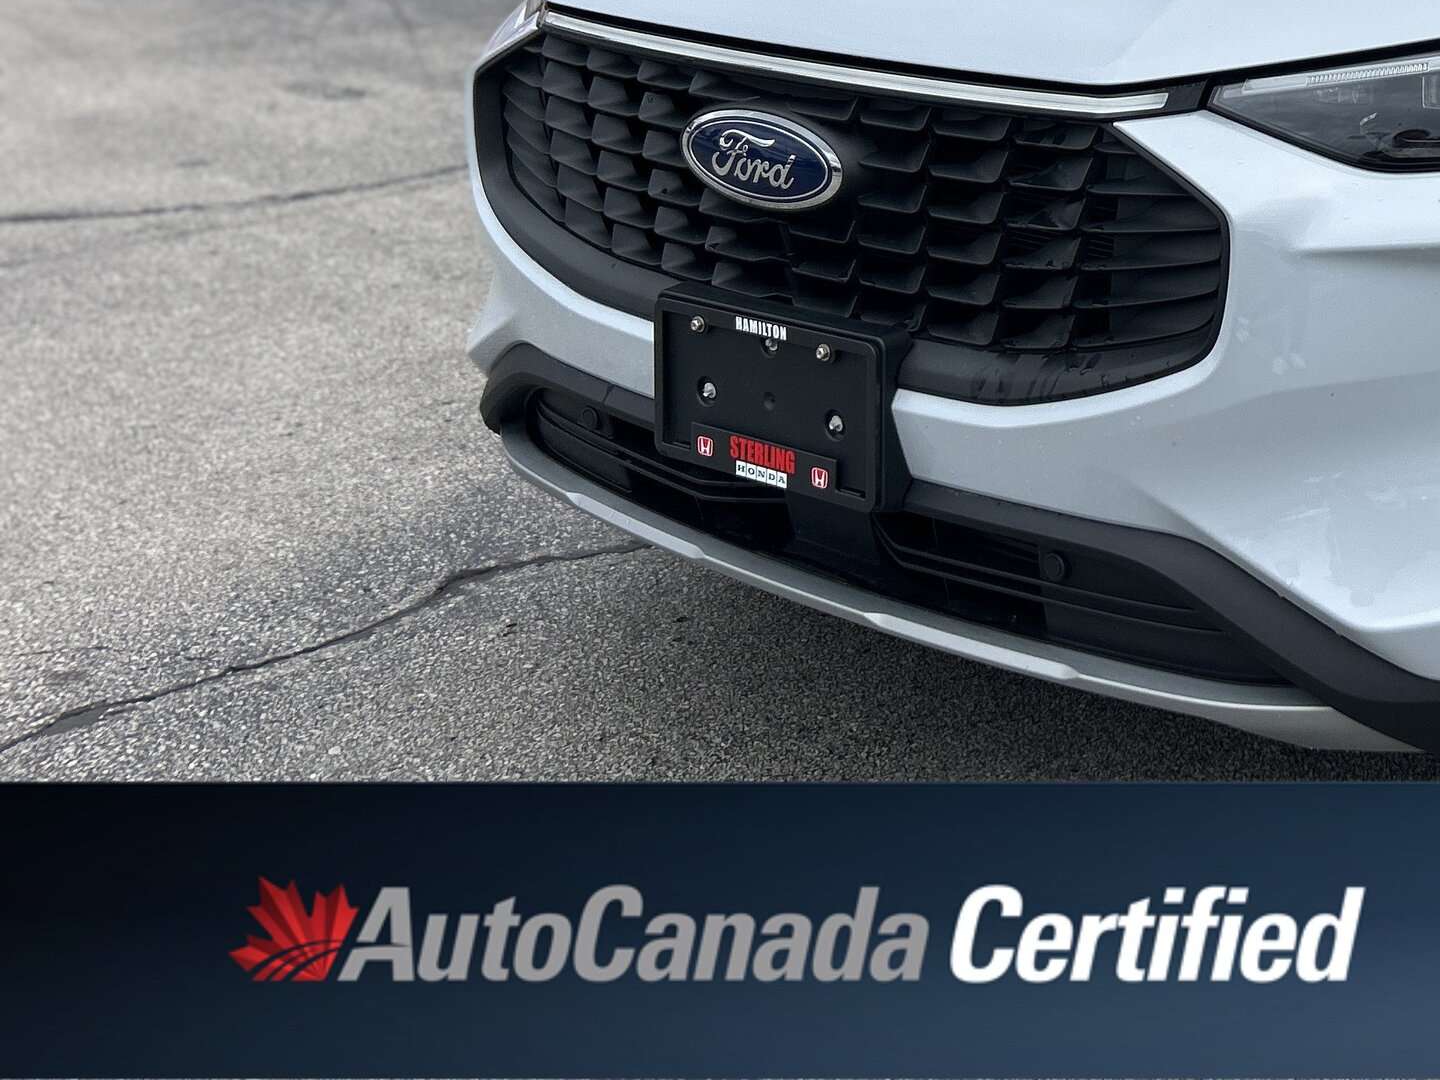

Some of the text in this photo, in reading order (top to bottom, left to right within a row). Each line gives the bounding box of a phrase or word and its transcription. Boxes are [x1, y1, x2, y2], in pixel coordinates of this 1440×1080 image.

[711, 128, 797, 191] Ford
[735, 316, 787, 341] HAMILTON
[730, 435, 796, 474] STERLING
[737, 462, 786, 486] HONDA
